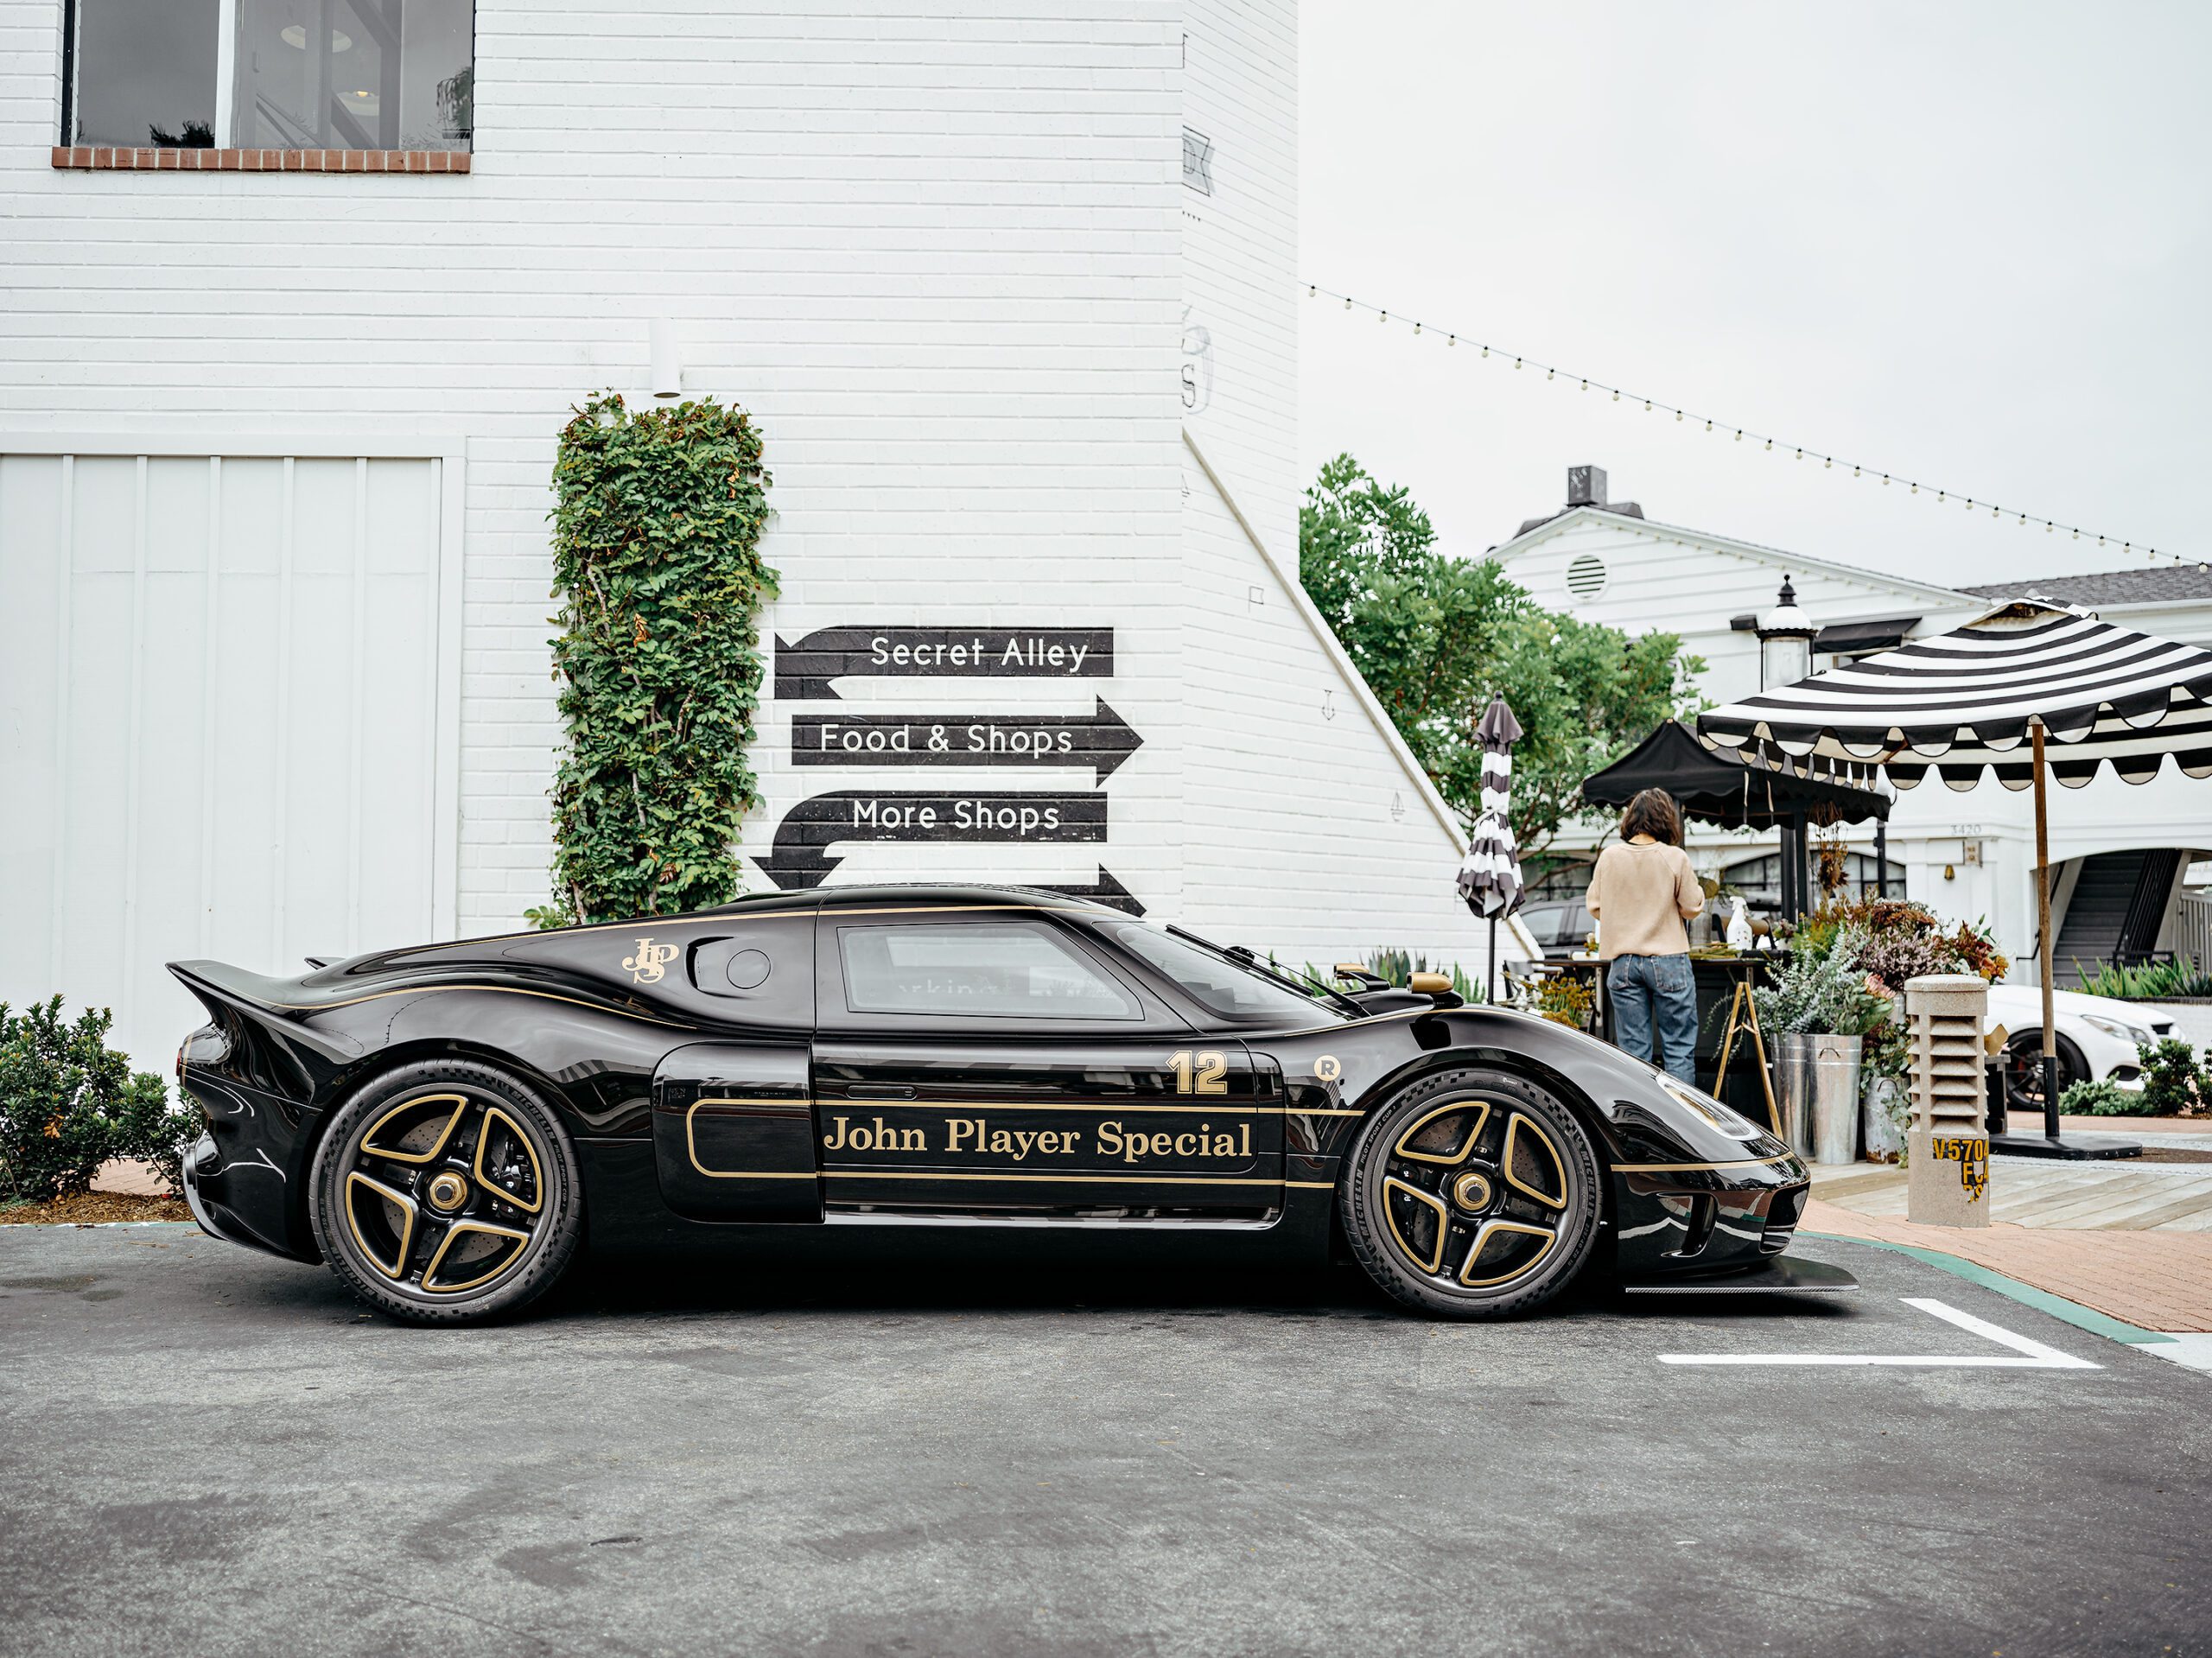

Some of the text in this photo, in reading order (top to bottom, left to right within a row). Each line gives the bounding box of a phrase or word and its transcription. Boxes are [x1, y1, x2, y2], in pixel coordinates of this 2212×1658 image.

[870, 637, 1089, 674] Secret Alley
[821, 724, 1073, 759] Food & Shops
[853, 800, 1059, 835] More Shops
[1950, 825, 1981, 835] 3420
[1166, 1050, 1227, 1094] 12
[1367, 1121, 1384, 1144] SPORT
[1381, 1109, 1394, 1123] CUP
[511, 1089, 558, 1141] MICHELIN
[559, 1164, 568, 1186] SPORT
[824, 1116, 1252, 1162] John Player Special
[1359, 1143, 1371, 1165] PILOT
[1580, 1149, 1595, 1218] MICHELIN
[1355, 1168, 1370, 1238] MICHELIN
[329, 1244, 377, 1299] MICHELIN
